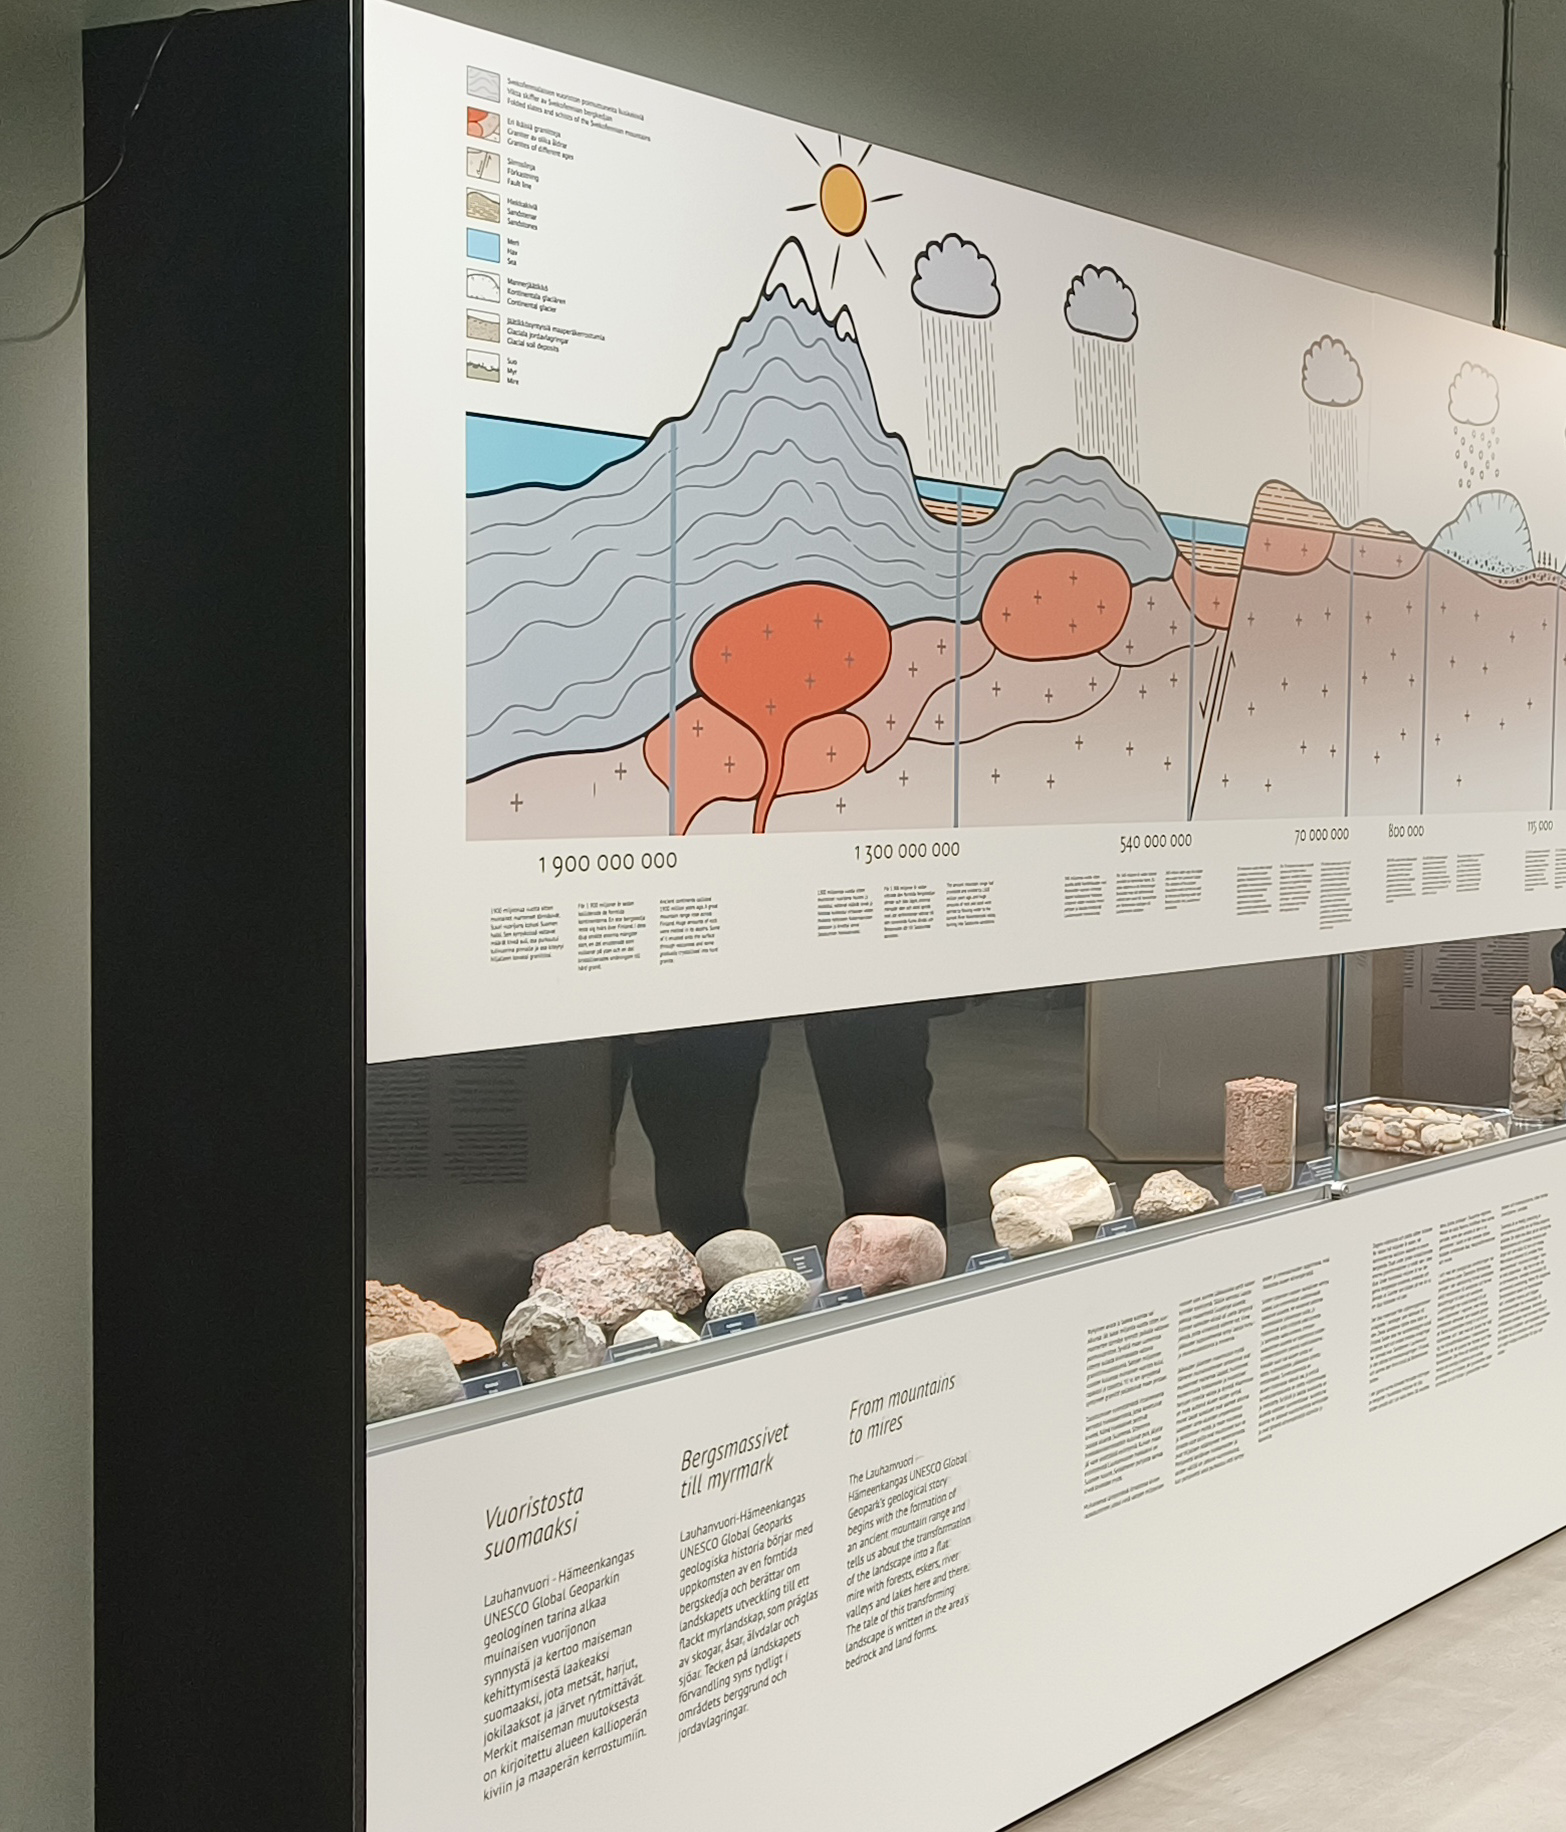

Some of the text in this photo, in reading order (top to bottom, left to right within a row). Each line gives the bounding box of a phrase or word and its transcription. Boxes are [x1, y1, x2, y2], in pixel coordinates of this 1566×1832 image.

[507, 257, 516, 265] Sea
[507, 357, 517, 365] Suo
[855, 842, 959, 864] 1 300 000 000
[1121, 834, 1192, 852] 540 000 000
[1295, 828, 1349, 845] 70 000 000
[1389, 824, 1424, 837] 800 000
[539, 852, 677, 877] 1 900 000 000
[849, 1375, 955, 1420] From mountains
[681, 1423, 789, 1471] Bergsmassivet
[849, 1415, 903, 1445] to mires
[681, 1452, 774, 1498] till myrmark
[848, 1453, 967, 1502] Hämeenkangas UNESCO Global
[887, 1482, 927, 1508] geological
[929, 1477, 948, 1491] story
[486, 1486, 583, 1529] Vuoristosta
[680, 1493, 805, 1542] Lauhanvuori-Hämeenkangas
[847, 1487, 956, 1536] begins with the formation of
[484, 1510, 579, 1560] suomaaksi
[680, 1514, 792, 1560] UNESCO Global Geoparks
[680, 1522, 813, 1581] geologiska historia börjar med
[484, 1575, 549, 1607] Lauhanvuori
[558, 1549, 634, 1582] Hämeenkangas
[484, 1572, 619, 1626] UNESCO Global Geoparkin
[679, 1563, 800, 1614] bergskedja och berättar om
[680, 1569, 735, 1597] uppkomsten
[737, 1564, 748, 1575] av
[750, 1560, 761, 1571] en
[846, 1602, 873, 1618] valleys
[875, 1592, 890, 1608] and
[892, 1586, 912, 1601] lakes
[914, 1579, 930, 1592] here
[932, 1570, 946, 1585] and
[484, 1596, 606, 1649] geologinen tarina alkaa
[679, 1575, 809, 1632] landskapets utveckling till ett
[679, 1632, 704, 1649] flackt
[767, 1602, 785, 1617] som
[787, 1590, 818, 1612] präglas
[846, 1623, 861, 1635] The
[863, 1615, 878, 1629] tale
[880, 1609, 889, 1622] of
[890, 1604, 904, 1618] this
[484, 1618, 596, 1665] muinaisen vuorijonon
[484, 1624, 632, 1686] synnystä ja kertoo maiseman
[678, 1655, 690, 1668] av
[746, 1620, 782, 1642] älvdalar
[784, 1613, 799, 1627] och
[704, 1656, 734, 1675] Tecken
[737, 1648, 747, 1666] på
[750, 1630, 801, 1657] landskapets
[845, 1648, 877, 1669] bedrock
[878, 1640, 893, 1655] and
[895, 1632, 912, 1648] land
[484, 1649, 609, 1704] kehittymisestä laakeaksi
[543, 1686, 563, 1705] jota
[678, 1675, 730, 1703] förvandling
[733, 1666, 752, 1683] syns
[754, 1654, 783, 1675] tydligt
[678, 1669, 786, 1721] områdets berggrund och
[483, 1712, 541, 1747] jokilaaksot
[543, 1708, 553, 1724] ja
[556, 1695, 585, 1719] järvet
[483, 1708, 647, 1782] on kirjoitettu alueen kallioperän
[484, 1694, 639, 1762] Merkit maiseman muutoksesta
[483, 1781, 512, 1801] kiviin
[515, 1775, 525, 1791] ja
[528, 1754, 579, 1783] maaperän
